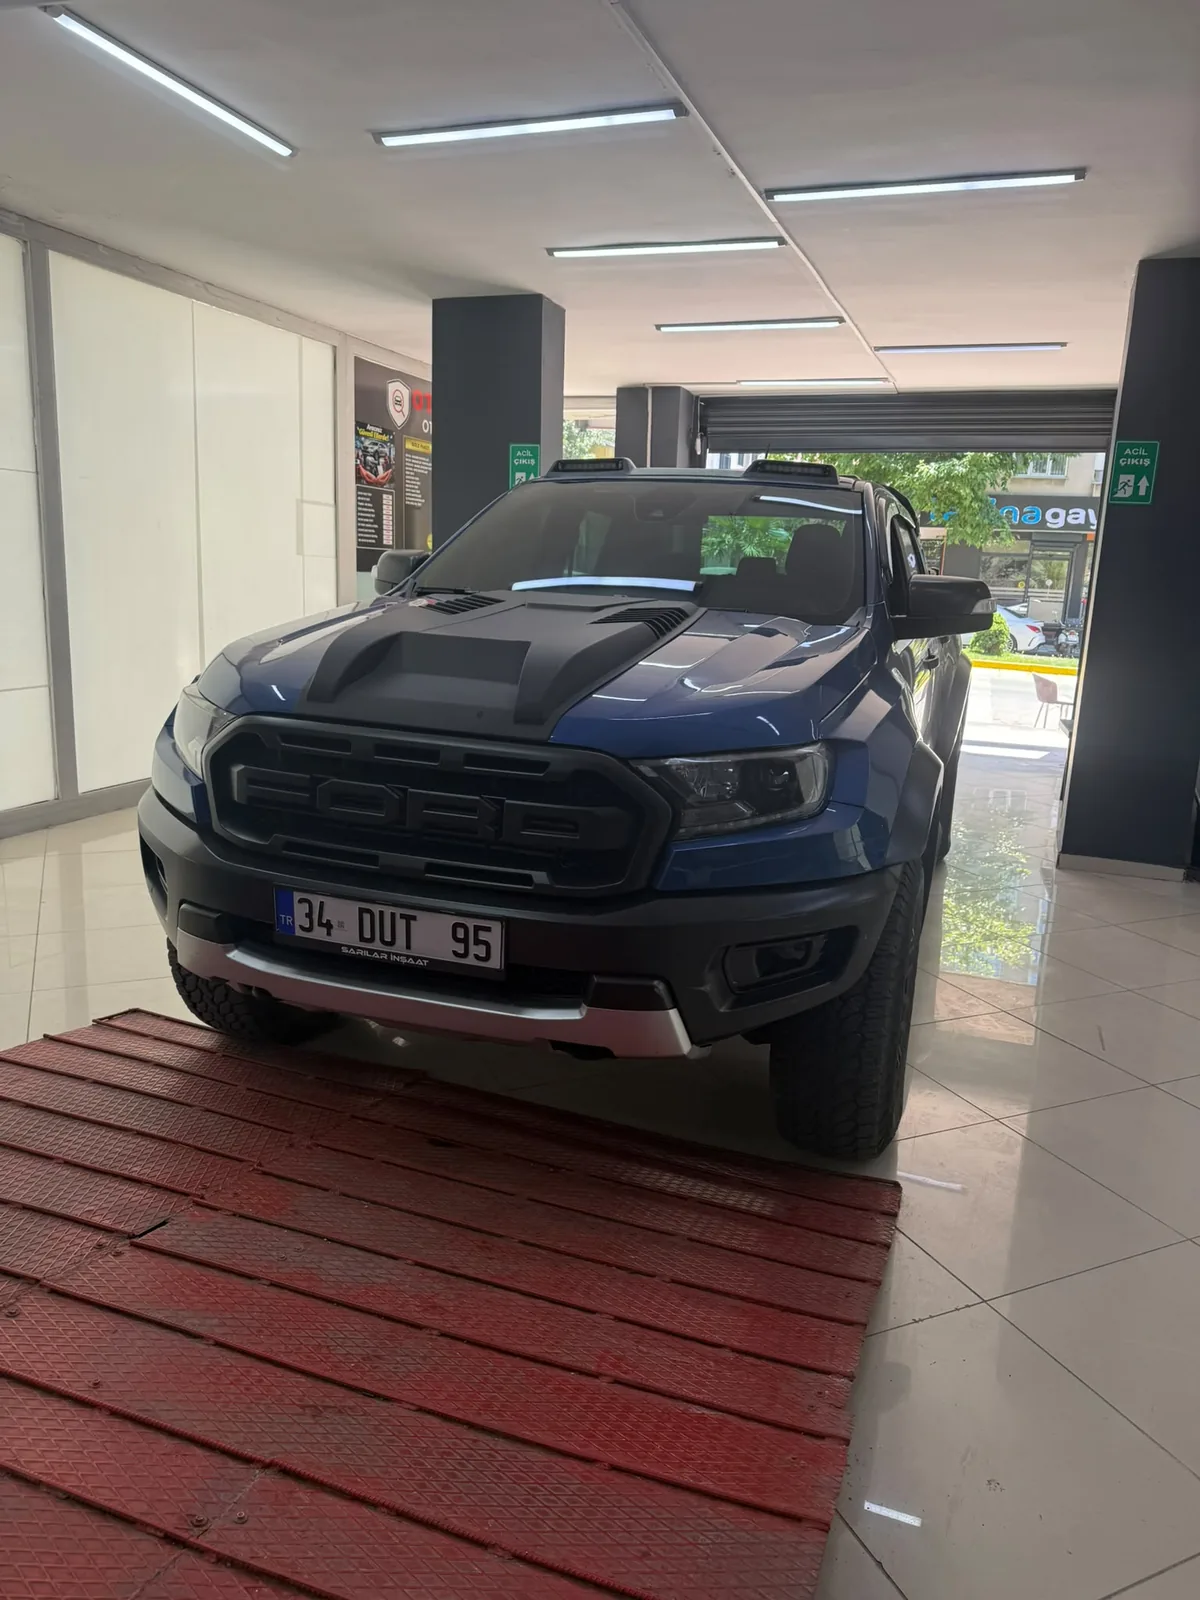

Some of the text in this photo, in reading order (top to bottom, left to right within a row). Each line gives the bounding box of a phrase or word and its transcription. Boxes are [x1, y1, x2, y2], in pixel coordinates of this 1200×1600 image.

[516, 449, 533, 457] ACİL
[1124, 446, 1148, 456] ACİL
[513, 458, 536, 466] ÇIKIŞ
[1119, 457, 1151, 467] ÇIKIŞ
[231, 765, 627, 851] FORD
[280, 914, 293, 926] TR
[297, 897, 492, 963] 34 DUT 95
[341, 946, 429, 967] SARILAR İNŞAAT
